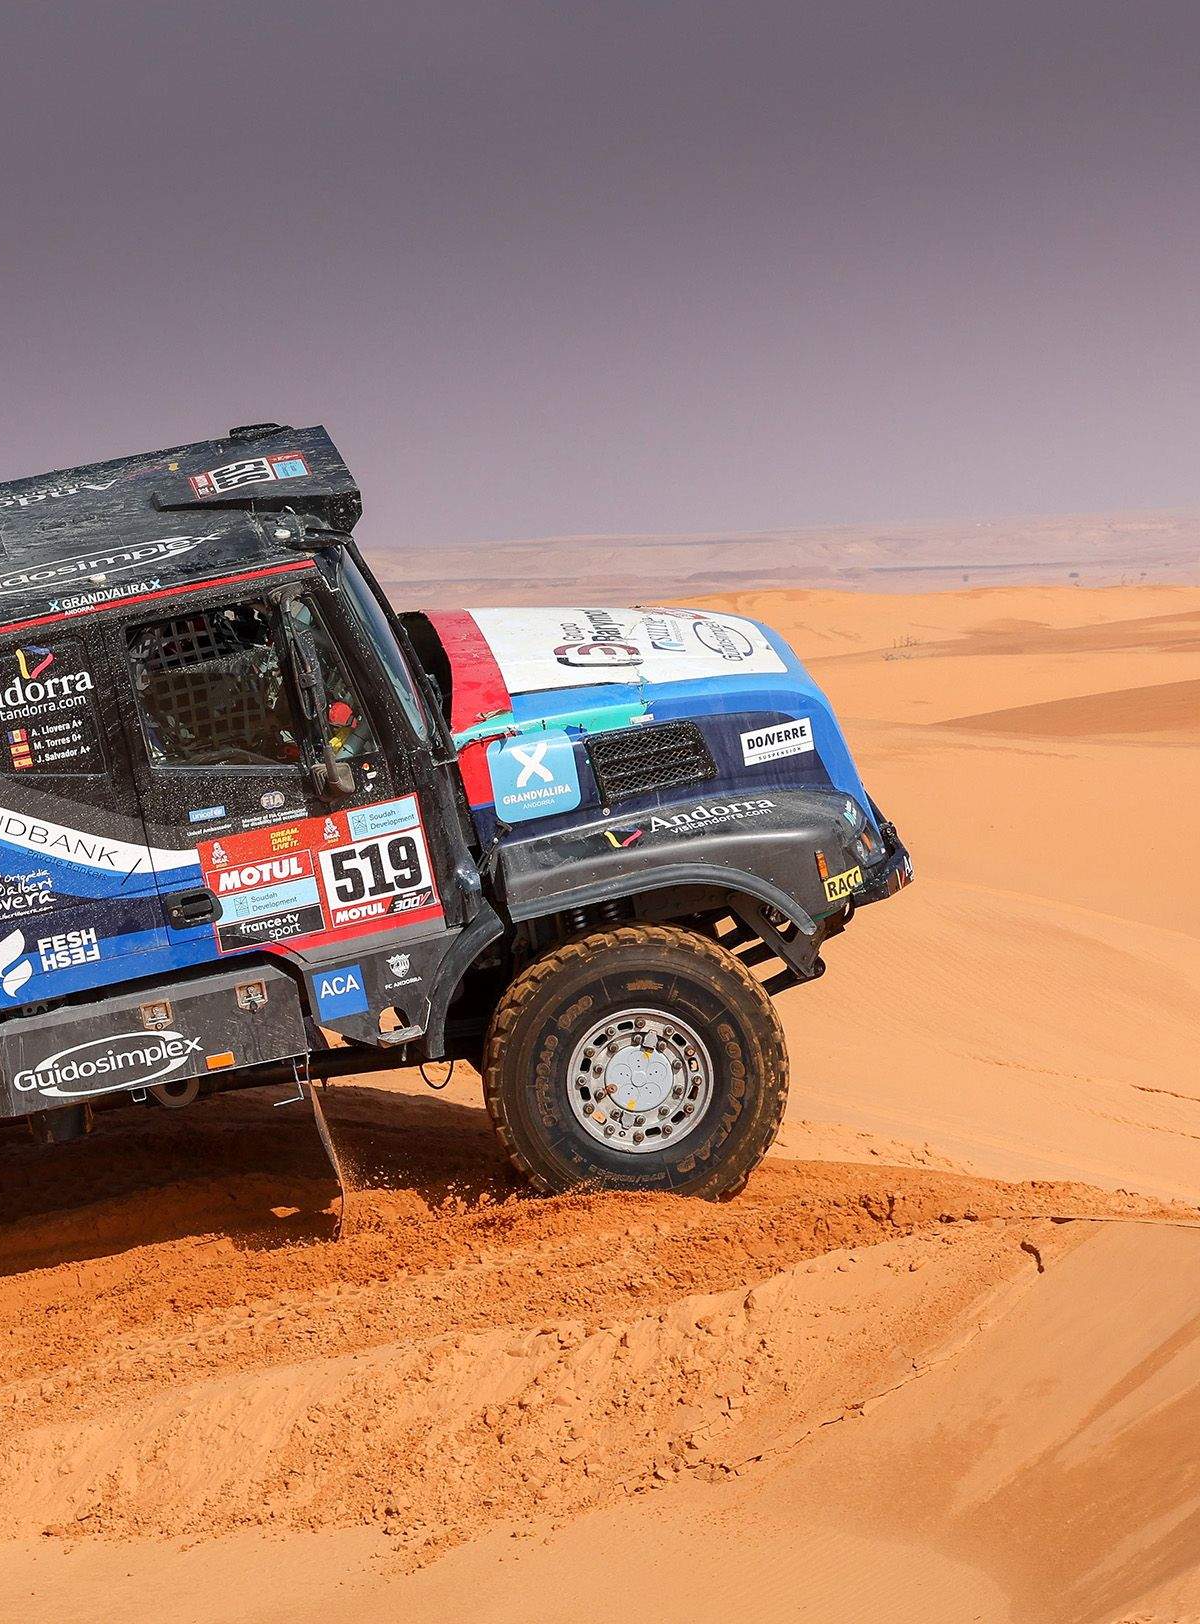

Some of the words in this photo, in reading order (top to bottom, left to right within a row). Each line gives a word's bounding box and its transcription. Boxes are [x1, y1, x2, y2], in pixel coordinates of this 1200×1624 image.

[61, 582, 149, 610] GRANDVALIRA
[64, 605, 96, 616] ANDORRA
[31, 728, 41, 737] A.
[41, 722, 71, 735] Llovera
[72, 719, 83, 728] A+
[33, 741, 45, 750] M.
[45, 736, 71, 748] Torres
[44, 749, 78, 762] Salvador
[80, 745, 91, 754] A+
[758, 746, 802, 761] SUSPENSION
[502, 783, 572, 805] GRANDVALIRA
[523, 798, 556, 810] ANDORRA
[369, 808, 397, 821] Soudah
[370, 813, 416, 830] Development
[649, 797, 776, 833] Andorra
[669, 808, 774, 835] visitandorra.com
[219, 857, 304, 892] MOTUL
[330, 835, 423, 903] 519
[6, 877, 54, 896] albert
[827, 868, 864, 899] RACC
[250, 890, 278, 904] Soudah
[251, 895, 298, 913] Development
[335, 902, 387, 924] MOTUL
[393, 890, 432, 913] 300V
[37, 927, 98, 955] FESH
[268, 921, 302, 942] sport
[320, 973, 361, 999] ACA
[384, 982, 394, 991] FC
[393, 976, 423, 988] ANDORRA
[13, 1035, 204, 1093] Guidosimplex
